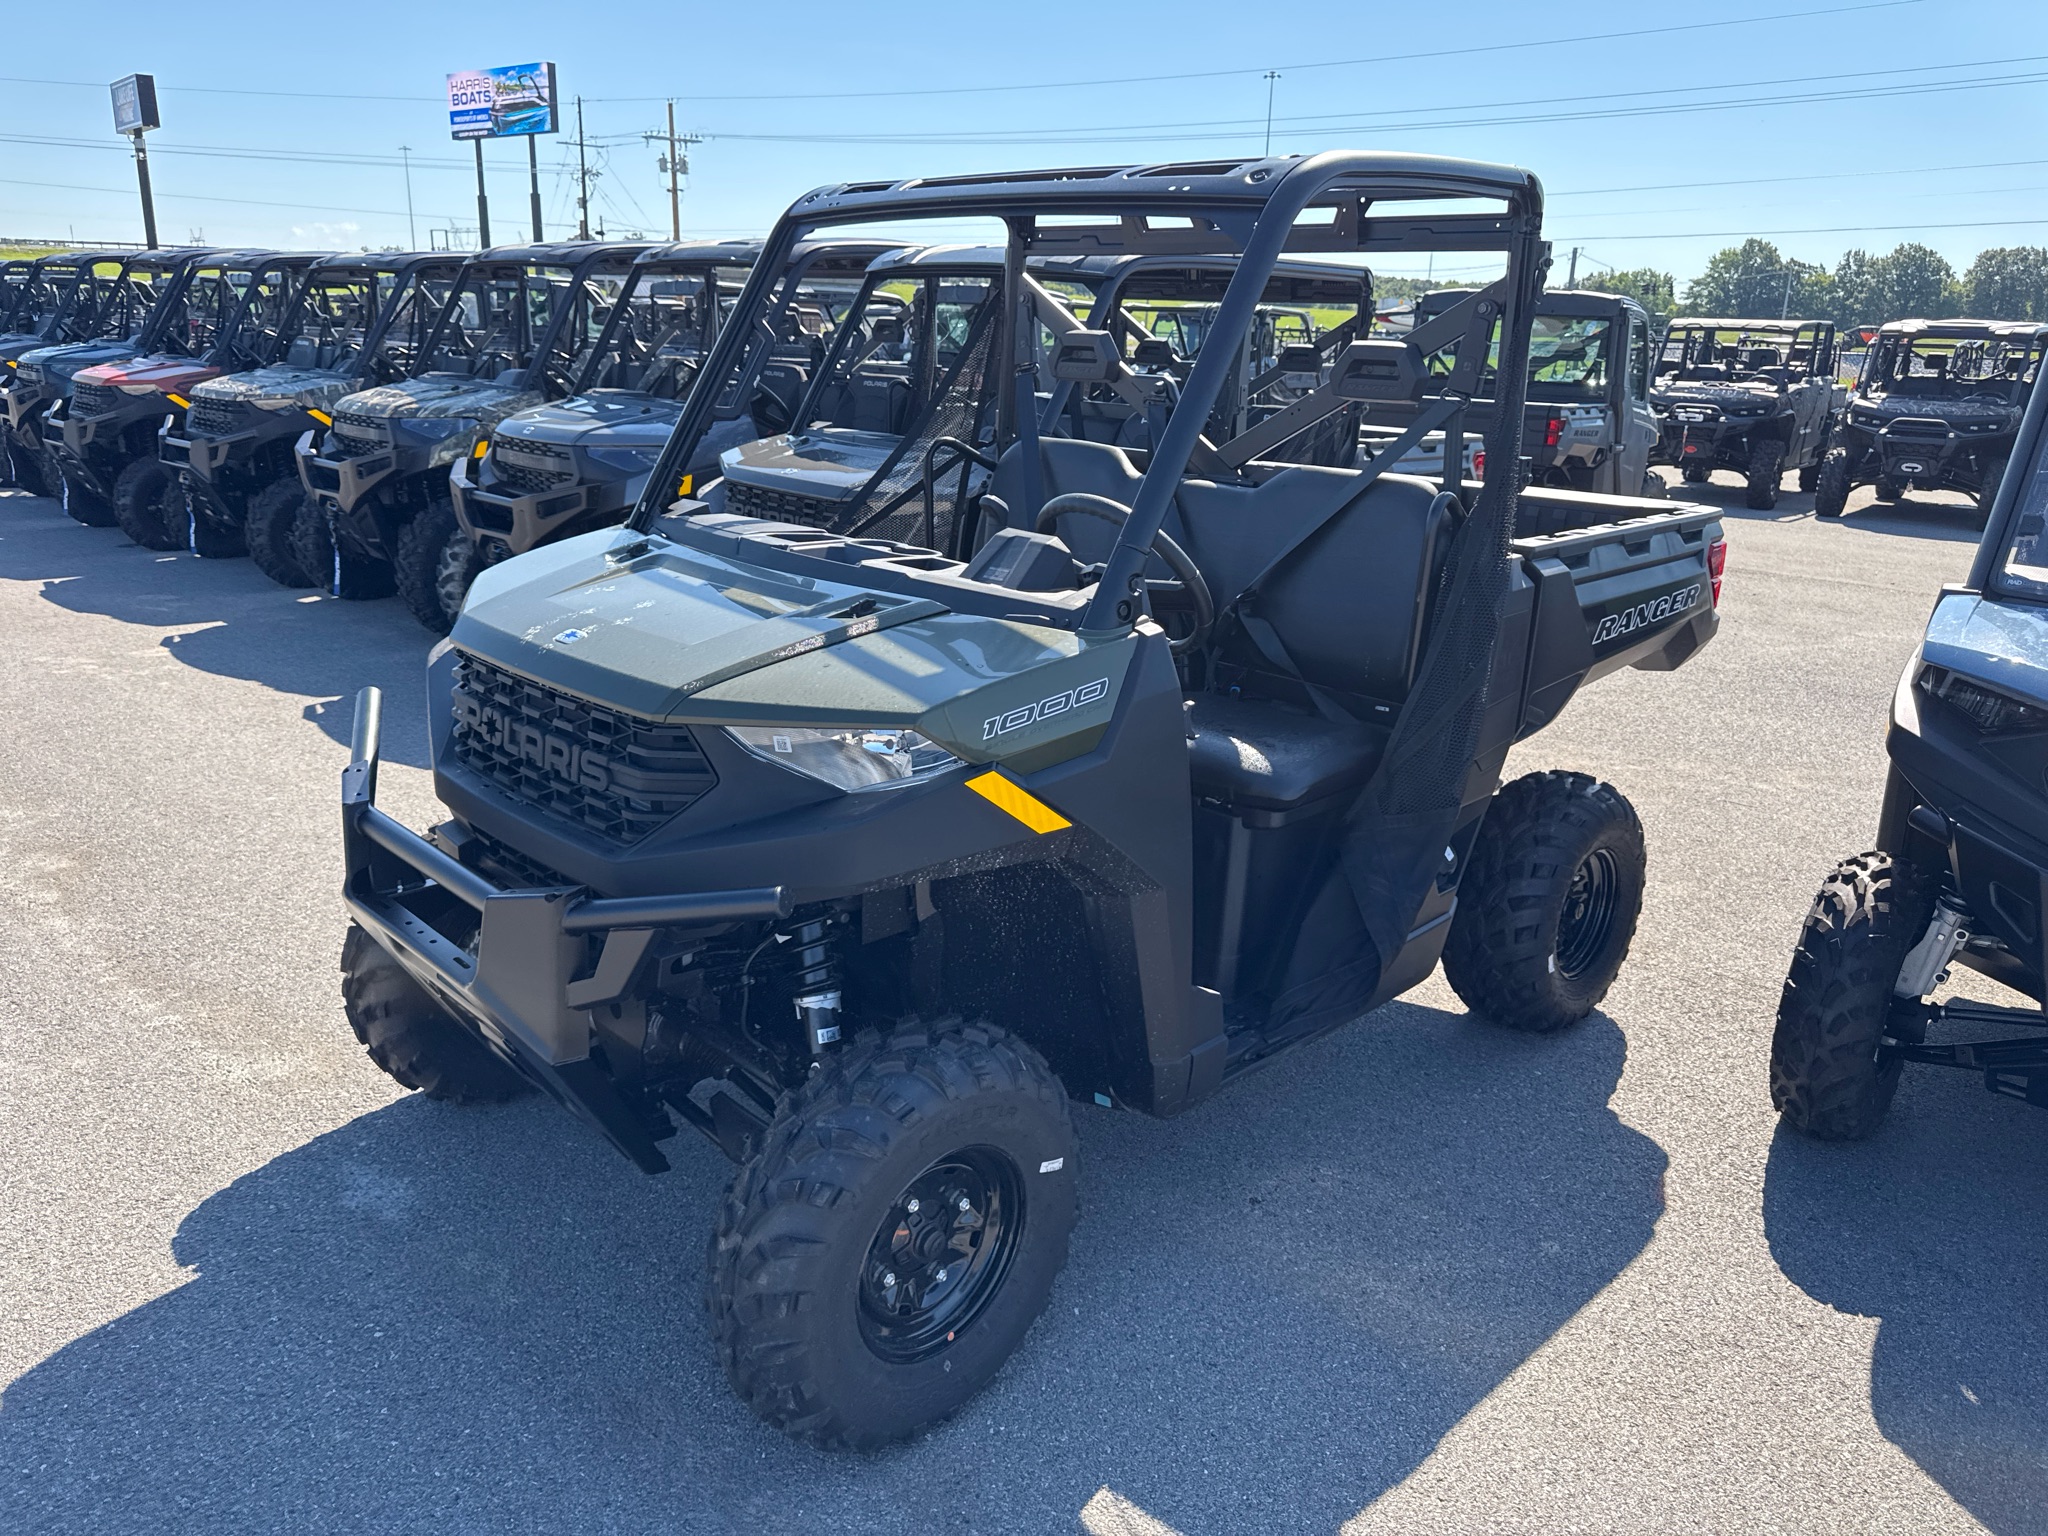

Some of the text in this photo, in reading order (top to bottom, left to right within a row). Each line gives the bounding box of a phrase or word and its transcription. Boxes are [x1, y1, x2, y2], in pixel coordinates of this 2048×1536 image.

[450, 77, 491, 93] HARRIS
[451, 90, 492, 106] BOATS
[763, 370, 785, 378] POLARIS
[863, 380, 888, 388] POLARIS
[1573, 429, 1600, 437] RANGER
[1591, 583, 1701, 645] RANGER
[982, 677, 1109, 741] 1000
[455, 694, 613, 793] POLARIS
